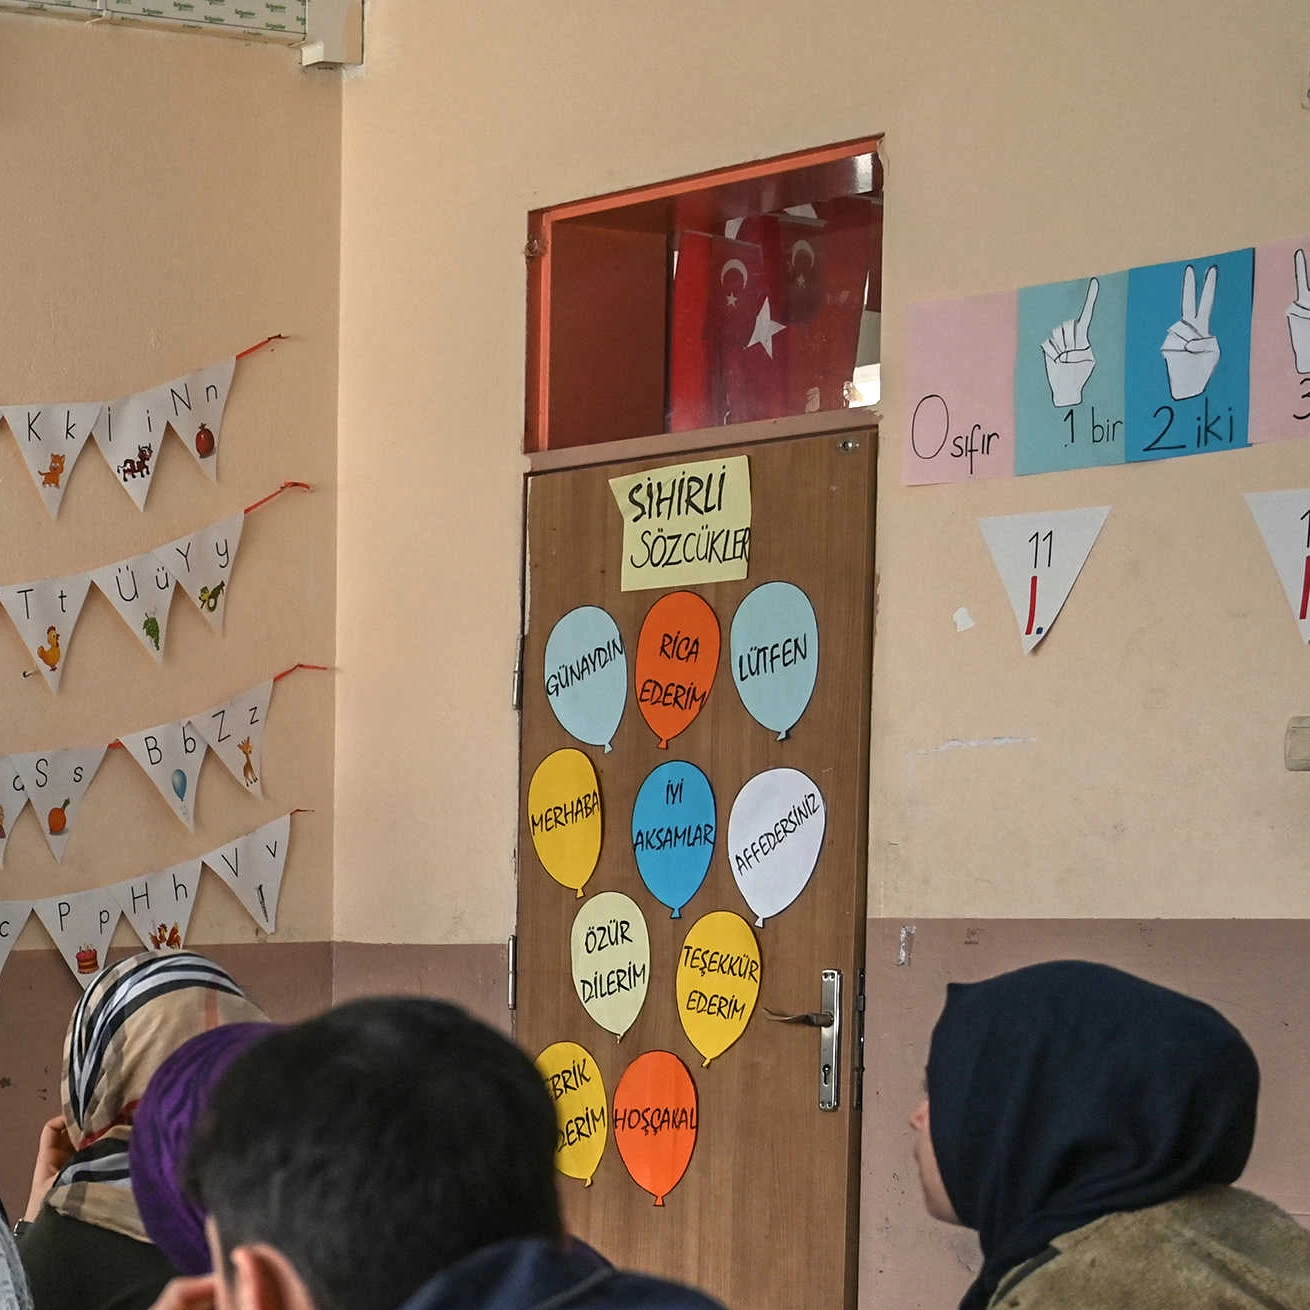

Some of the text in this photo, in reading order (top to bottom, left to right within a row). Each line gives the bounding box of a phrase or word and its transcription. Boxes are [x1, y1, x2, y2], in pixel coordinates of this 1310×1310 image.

[171, 384, 217, 416] N n
[28, 410, 76, 441] K k
[147, 410, 151, 432] i
[912, 394, 949, 459] 0
[1064, 406, 1122, 444] 1 bir
[1143, 397, 1233, 452] 2 iki
[629, 465, 726, 523] SİHİRLİ
[176, 539, 229, 572] Y y
[631, 526, 750, 568] SÖZCÜKLER
[1029, 530, 1052, 568] 11
[116, 566, 169, 601] Ü ü
[17, 589, 67, 619] T t
[659, 631, 700, 664] RİCA
[738, 633, 808, 682] LÜTFEN
[547, 637, 624, 696] GÜNAYDIN
[640, 679, 707, 710] EDERİM
[212, 707, 259, 742] Z z
[145, 721, 196, 765] B b
[36, 759, 83, 787] S s
[666, 778, 683, 804] İYİ
[532, 792, 600, 835] MERHABA
[735, 794, 820, 875] AFFEDERSİNİZ
[221, 841, 277, 877] V v
[131, 874, 187, 914] H h
[0, 921, 9, 937] c
[58, 902, 109, 934] P p
[585, 920, 633, 954] ÖZÜR
[684, 945, 760, 983] TEŞEKKÜR
[581, 962, 646, 1003] DİLERİM
[686, 991, 746, 1020] EDERİM
[613, 1107, 698, 1136] HOŞÇAKAL
